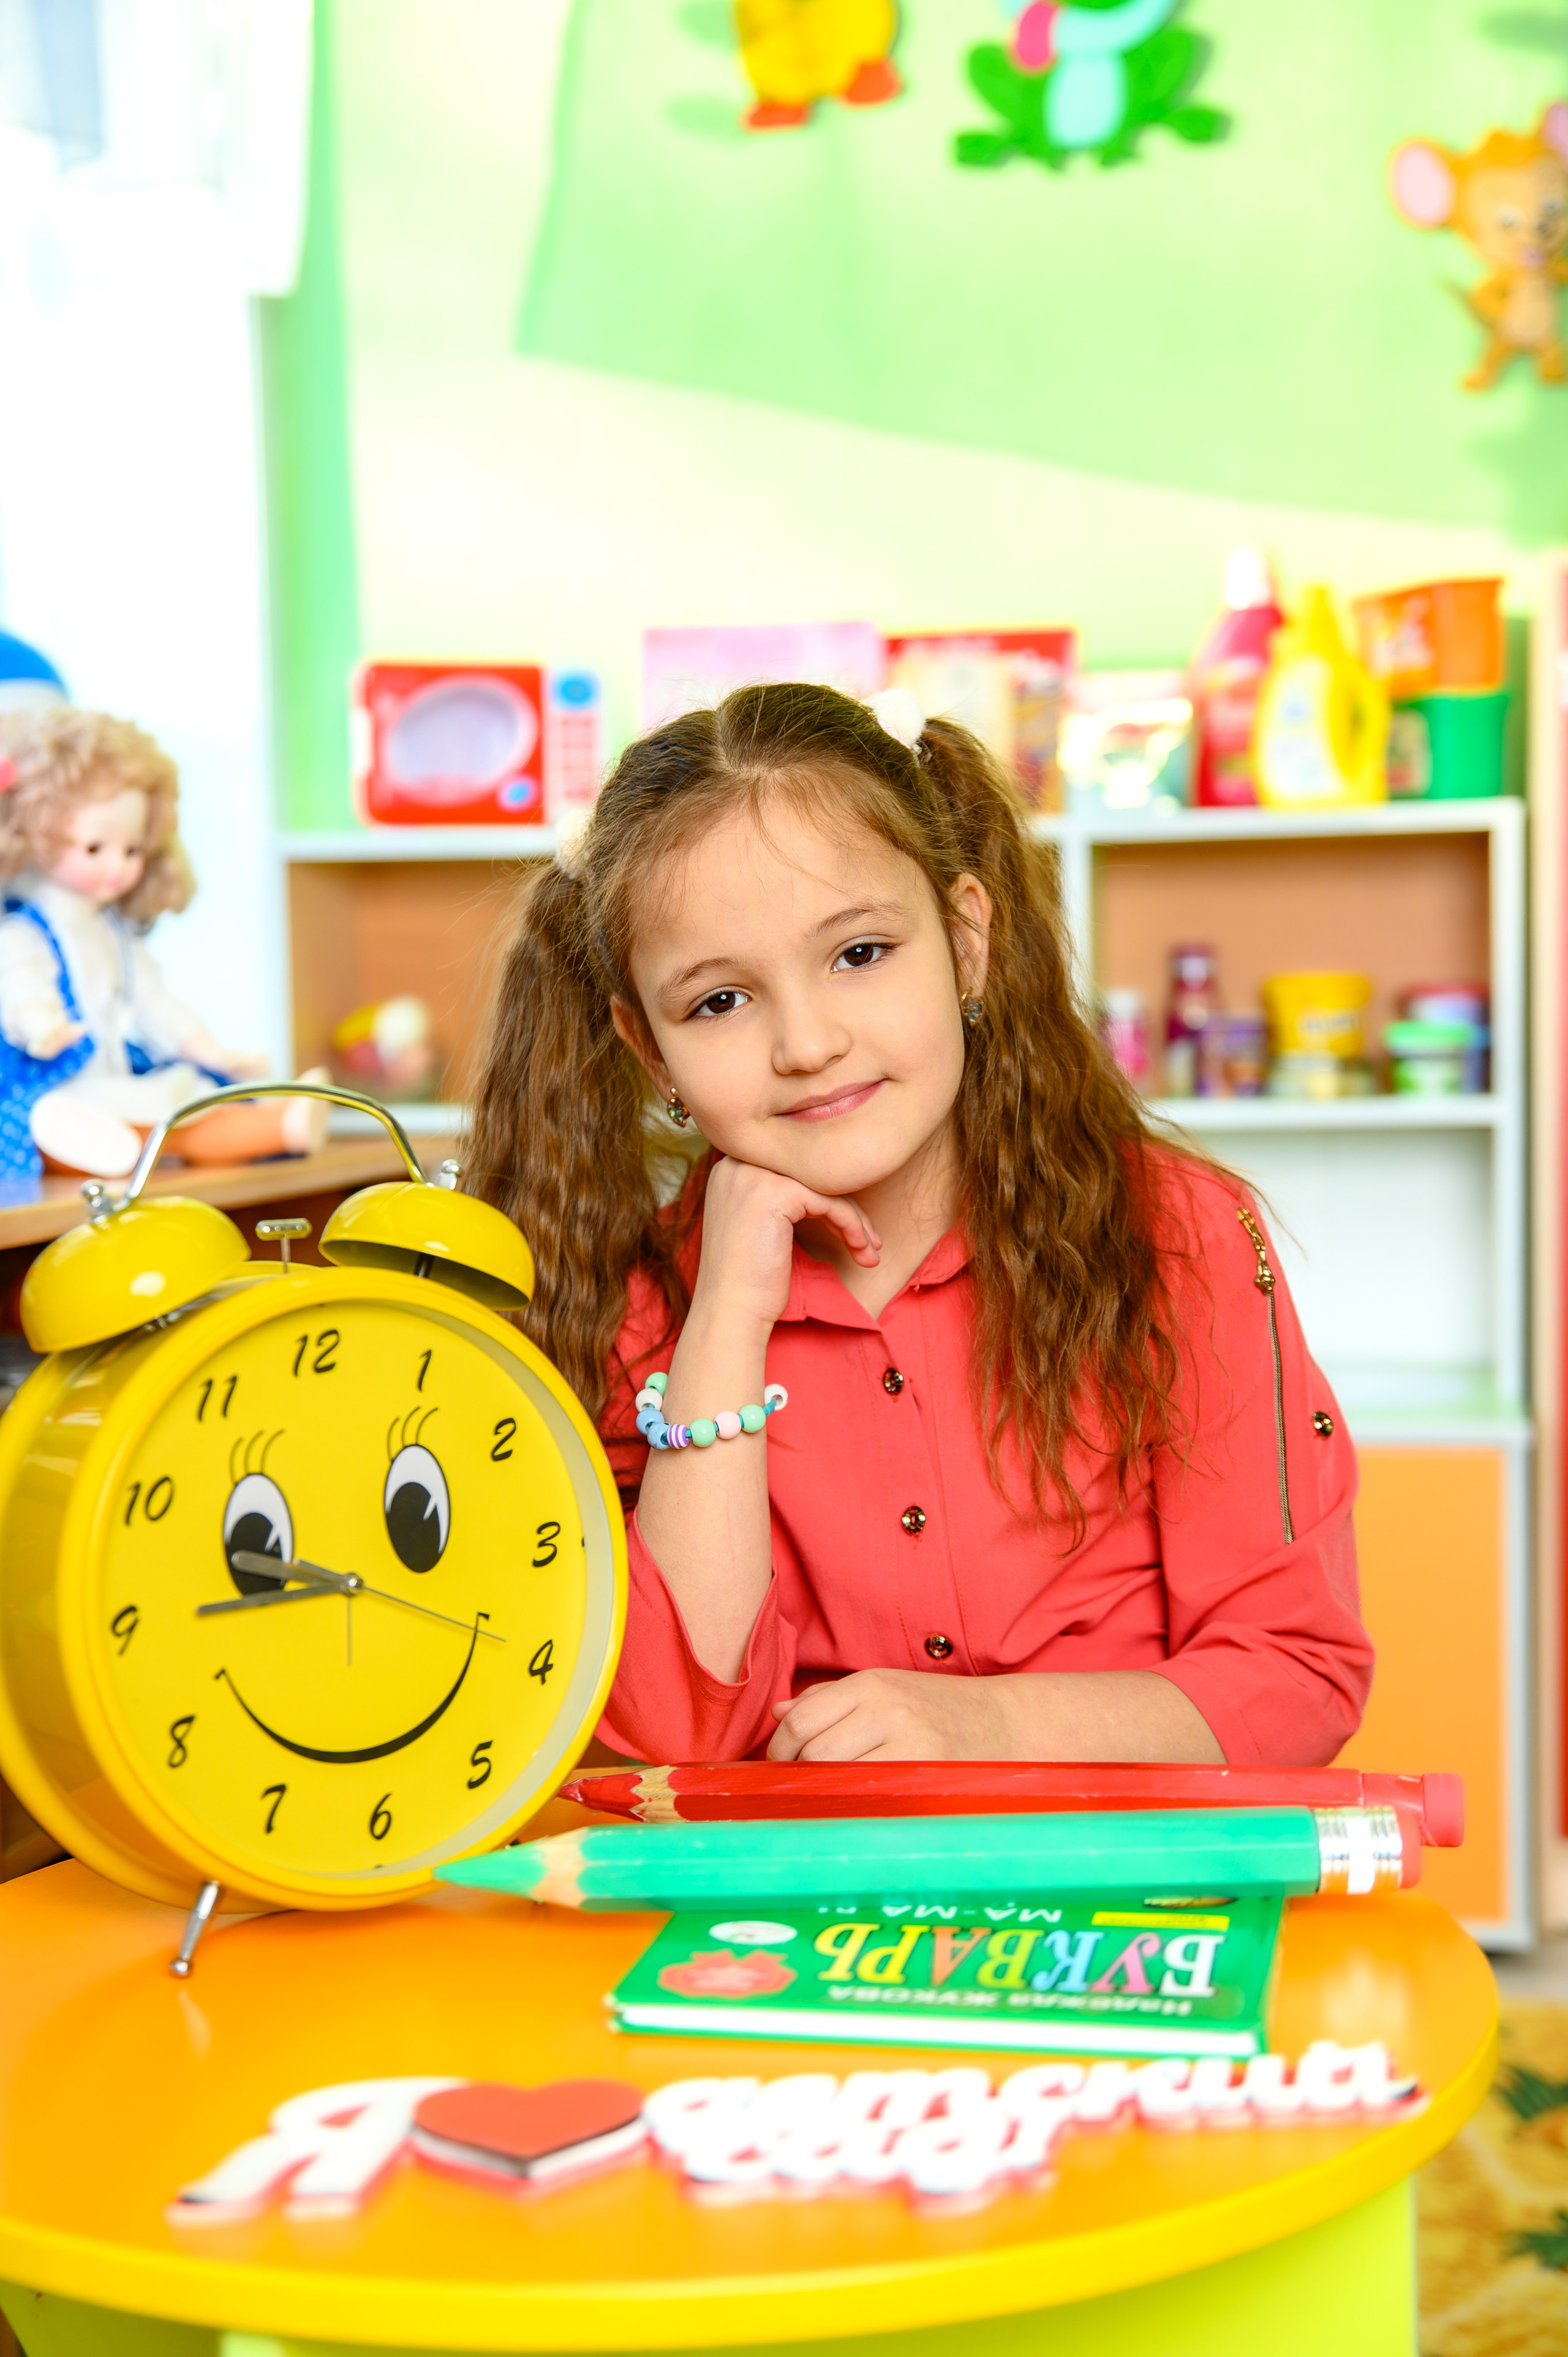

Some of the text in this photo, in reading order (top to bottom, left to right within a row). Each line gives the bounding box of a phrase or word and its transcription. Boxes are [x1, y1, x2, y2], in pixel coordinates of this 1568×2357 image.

[293, 1329, 340, 1378] 12
[417, 1349, 432, 1392] 1
[197, 1375, 238, 1422] 11
[490, 1417, 517, 1462] 2
[124, 1476, 174, 1526] 10
[532, 1521, 561, 1568] 3
[110, 1604, 140, 1655] 9
[527, 1639, 554, 1686] 4
[168, 1714, 196, 1769] 8
[466, 1740, 494, 1790] 5
[261, 1783, 288, 1835] 7
[369, 1793, 393, 1841] 6
[813, 1922, 1226, 1998] БУКВАРЬ
[173, 2075, 475, 2205] Я
